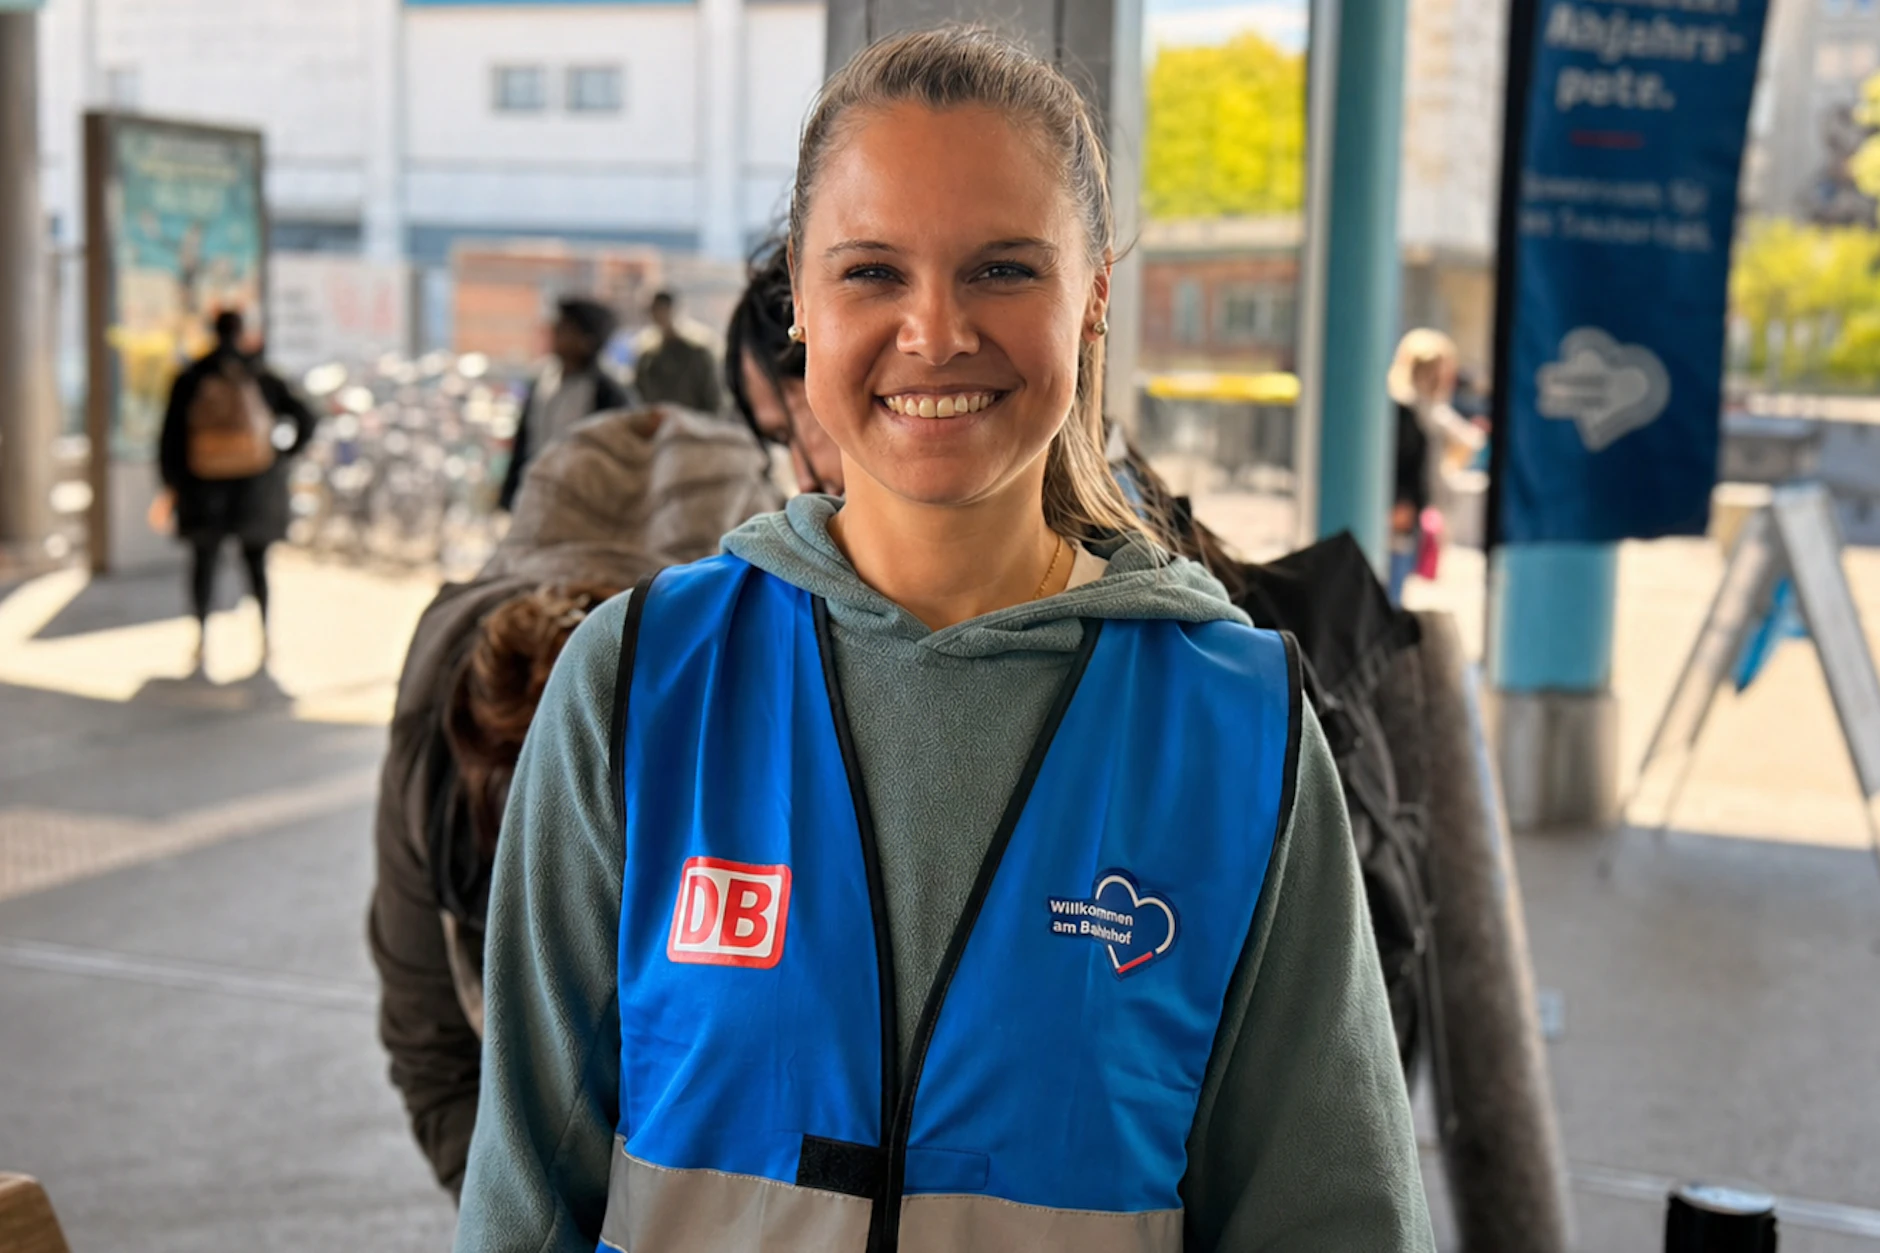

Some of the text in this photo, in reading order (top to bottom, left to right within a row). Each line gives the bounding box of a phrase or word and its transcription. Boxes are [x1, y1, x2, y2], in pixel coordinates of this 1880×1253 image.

[679, 875, 773, 948] DB
[1050, 900, 1133, 926] Willkommen
[1053, 920, 1076, 934] am
